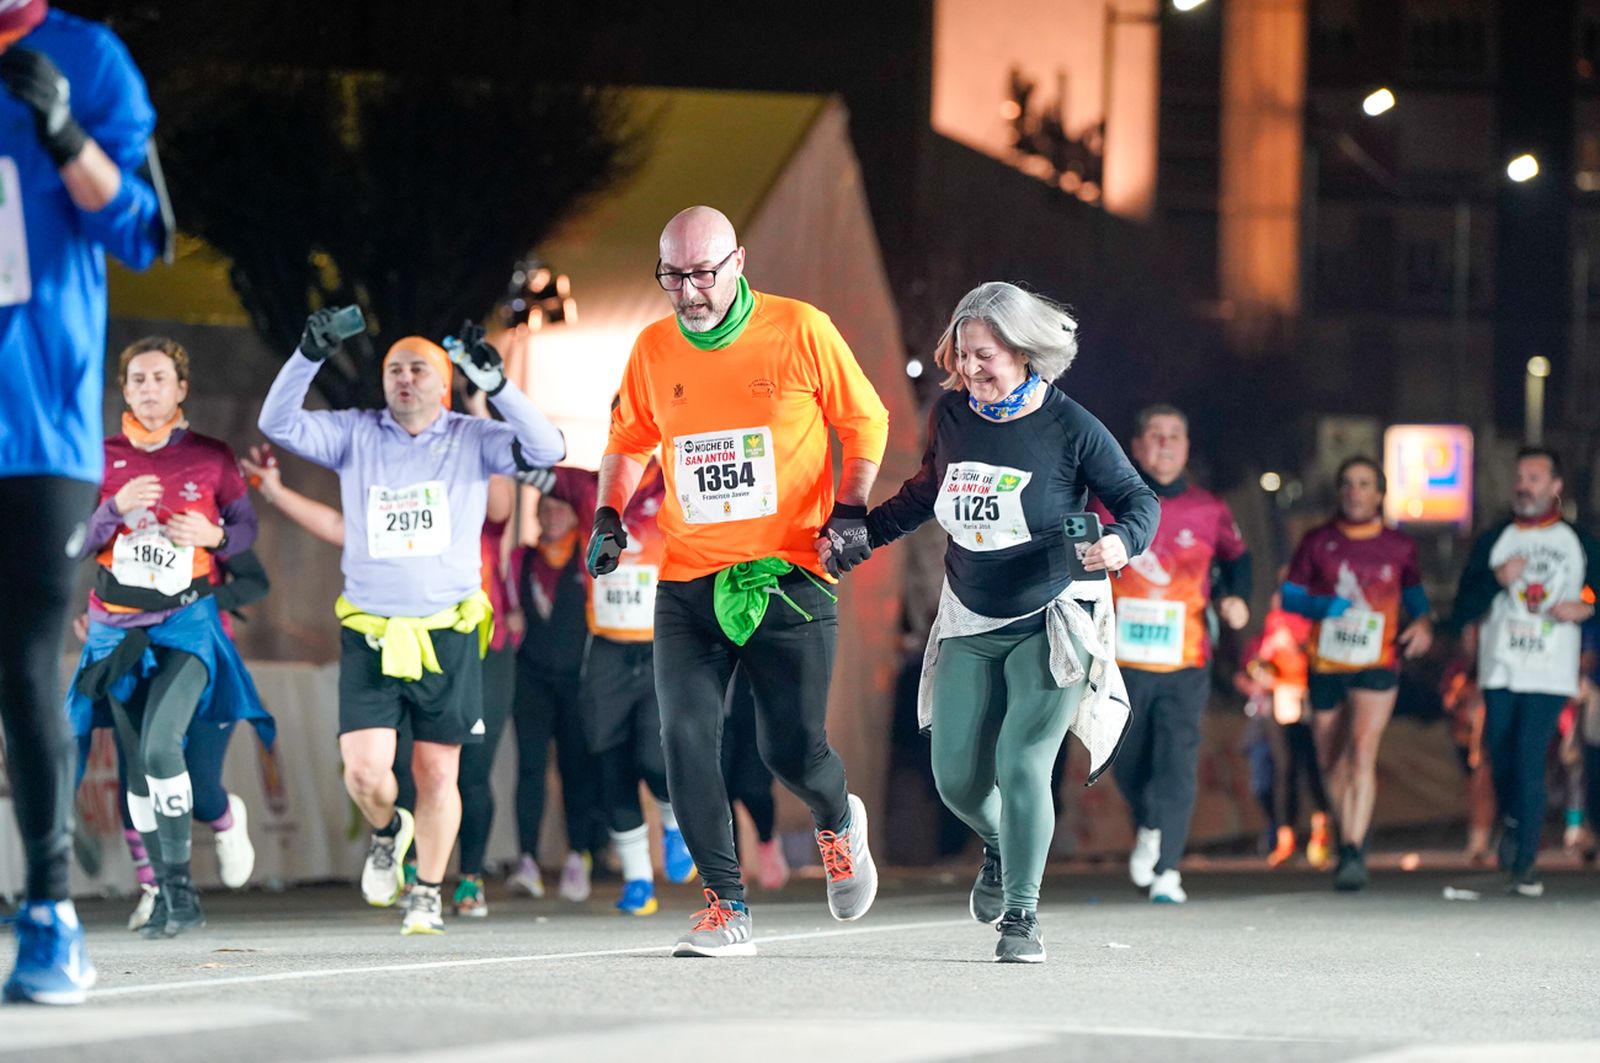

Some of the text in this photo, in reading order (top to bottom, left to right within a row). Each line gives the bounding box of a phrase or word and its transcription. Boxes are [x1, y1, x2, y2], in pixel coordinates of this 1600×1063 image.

[686, 455, 703, 465] SAN
[704, 450, 735, 464] ANTÓN
[695, 442, 721, 452] NOCHE
[724, 440, 734, 449] DE
[694, 461, 756, 492] 1354
[386, 509, 432, 531] 2979
[952, 496, 1000, 521] 1125
[134, 545, 176, 569] 1862
